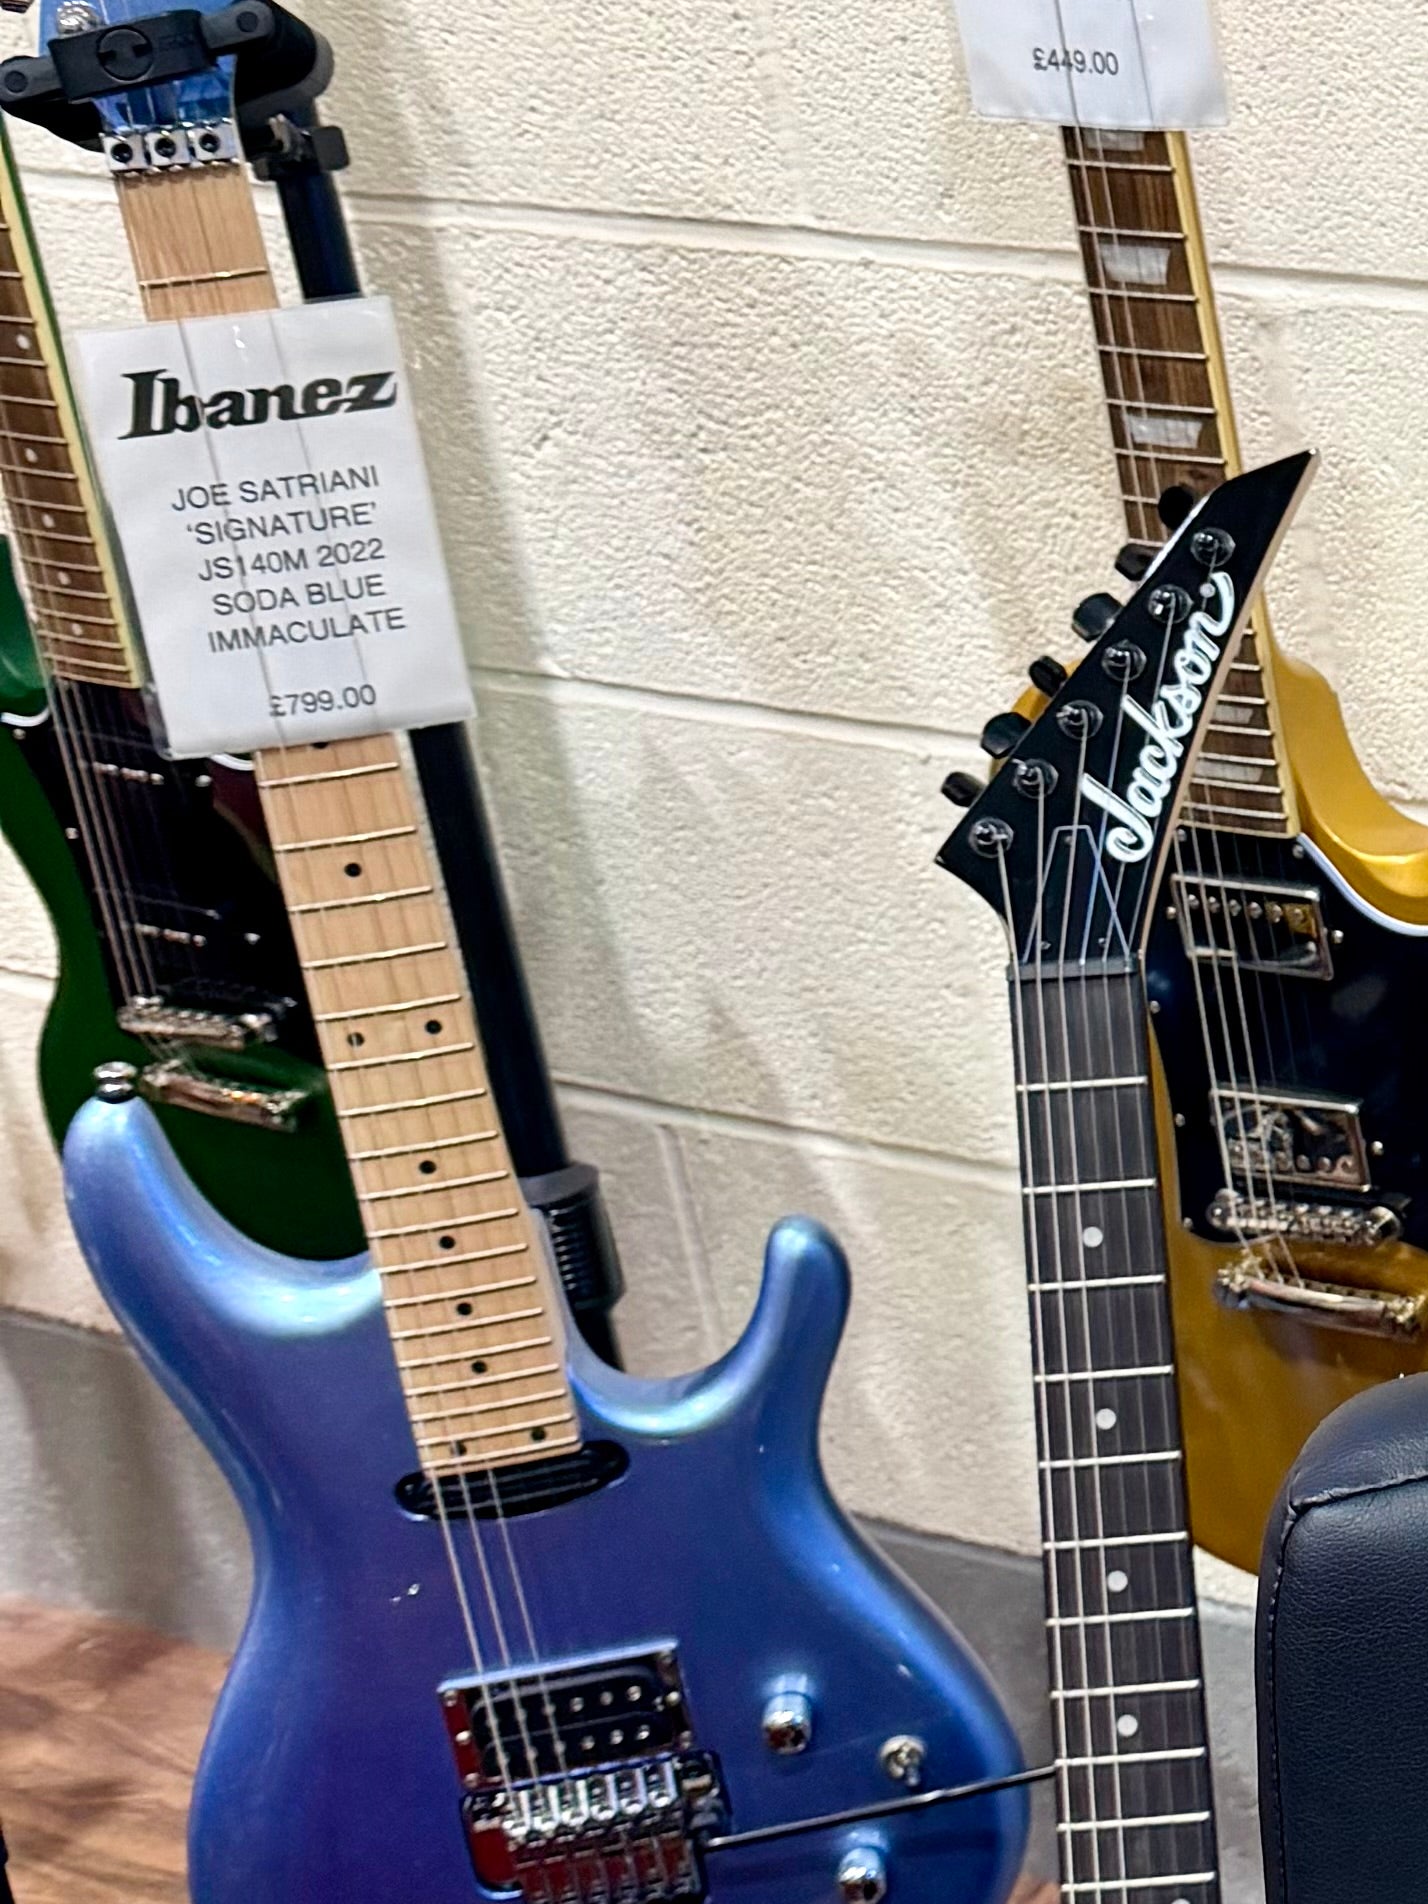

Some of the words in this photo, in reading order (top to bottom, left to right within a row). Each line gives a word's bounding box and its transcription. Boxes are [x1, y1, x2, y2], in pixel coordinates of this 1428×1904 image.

[1032, 47, 1119, 75] £449.00
[118, 368, 398, 440] Ibanez
[172, 483, 232, 512] JOE
[240, 465, 380, 503] SATRIANI
[199, 548, 308, 582] JS140M
[317, 538, 386, 568] 2022
[212, 587, 299, 616] SODA
[307, 574, 386, 605] BLUE
[208, 607, 407, 653] IMMACULATE
[269, 684, 377, 717] £799.00
[1081, 571, 1235, 862] Jackson
